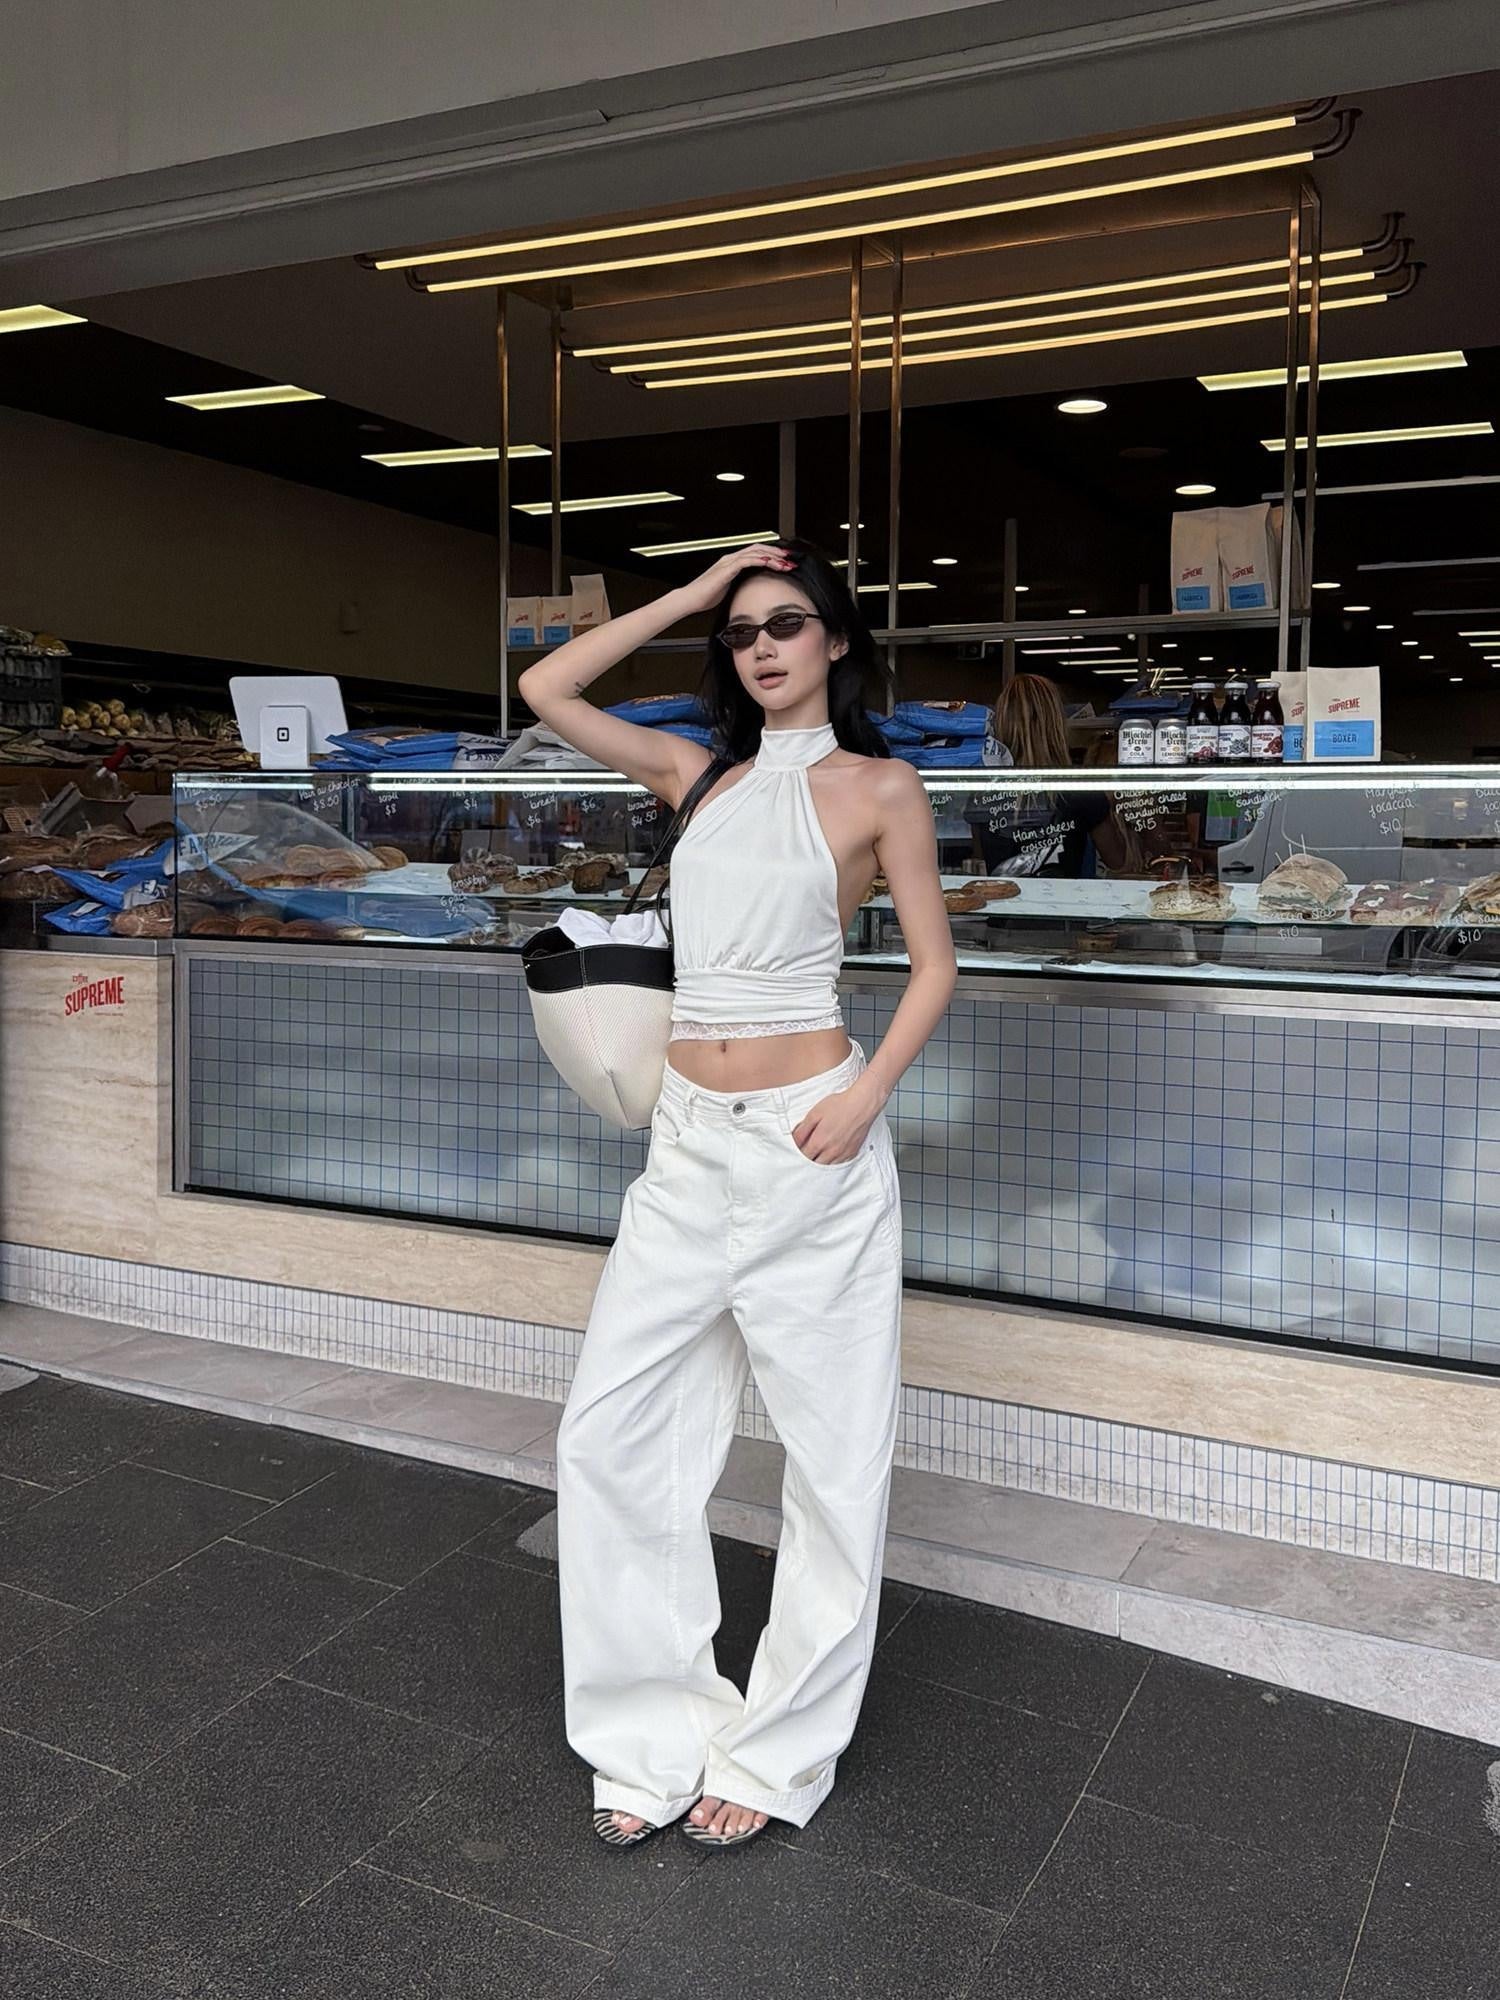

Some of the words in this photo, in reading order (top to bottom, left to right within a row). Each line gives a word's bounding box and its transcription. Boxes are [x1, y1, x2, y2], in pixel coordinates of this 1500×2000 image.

[1327, 697, 1361, 714] SUPREME
[1332, 733, 1357, 743] BOXER
[463, 798, 478, 811] $4
[580, 797, 597, 813] $6
[1236, 793, 1282, 808] sandwich
[385, 803, 397, 817] $8
[1124, 805, 1170, 822] sandwich
[1244, 807, 1266, 822] $15
[527, 812, 542, 829] $6
[988, 816, 1008, 833] $10
[1134, 817, 1157, 833] $15
[1379, 817, 1403, 836] $10
[1012, 828, 1038, 842] Ham
[1046, 819, 1076, 834] cheese
[1020, 834, 1066, 854] croissant
[1457, 928, 1482, 945] $10
[65, 976, 125, 1016] SUPREME
